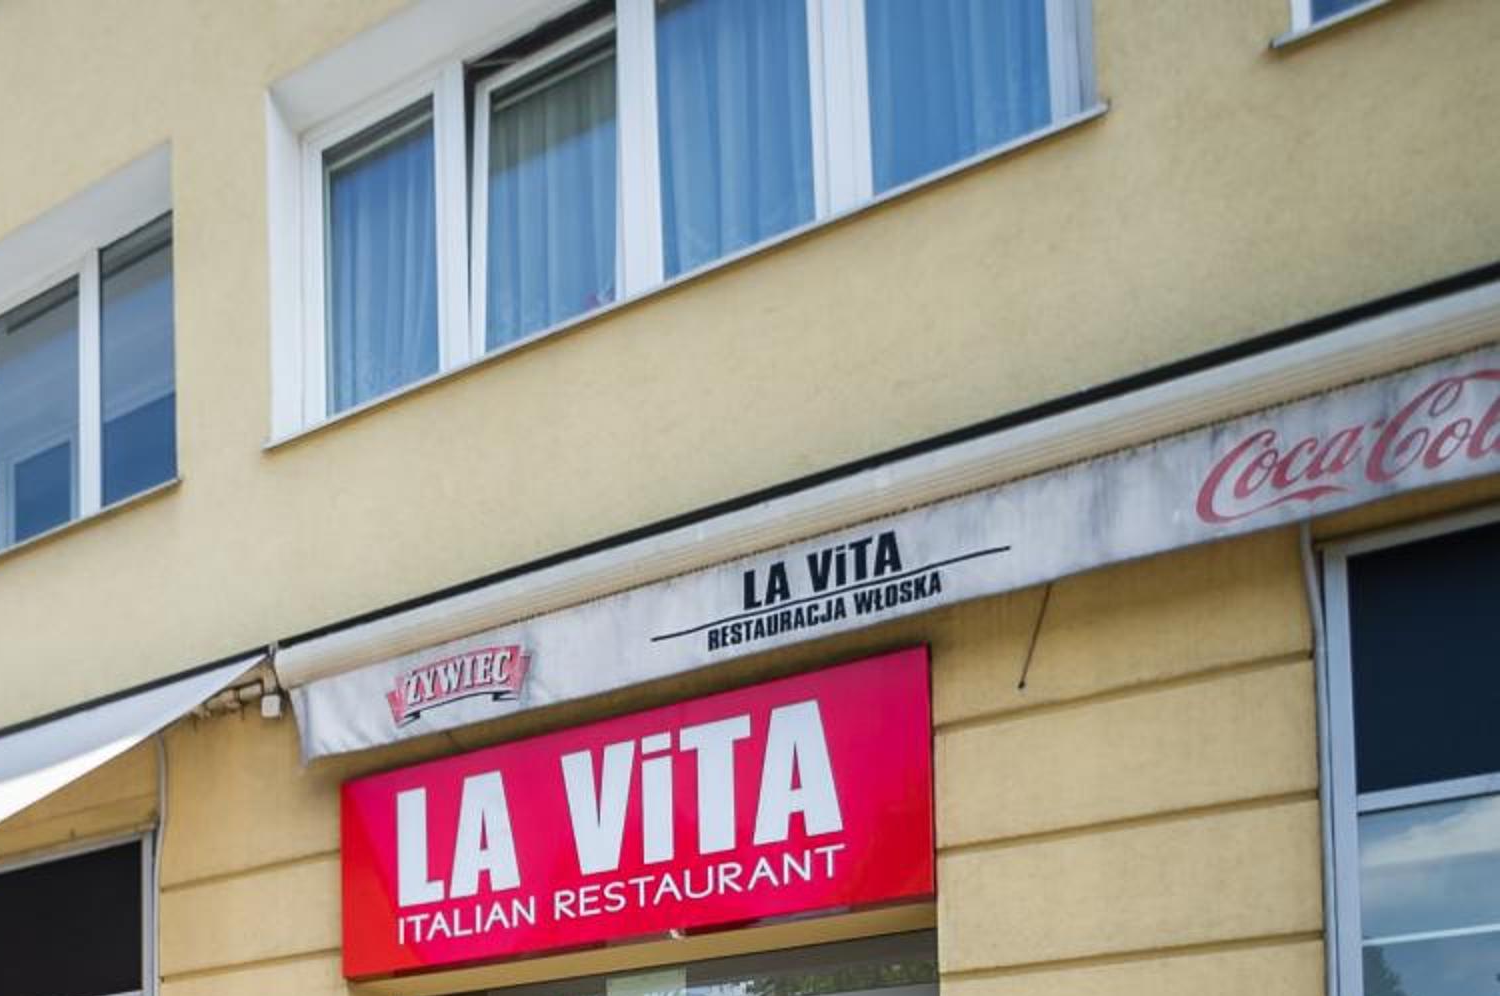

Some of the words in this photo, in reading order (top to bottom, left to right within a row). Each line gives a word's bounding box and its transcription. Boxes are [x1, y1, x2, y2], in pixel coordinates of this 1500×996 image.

[1195, 368, 1500, 523] Coca-Col
[707, 596, 847, 652] RESTAURACJA
[853, 570, 943, 616] WŁOSKA
[742, 560, 792, 611] LA
[396, 769, 522, 908] LA
[397, 895, 536, 945] ITALIAN
[552, 843, 847, 921] RESTAURANT
